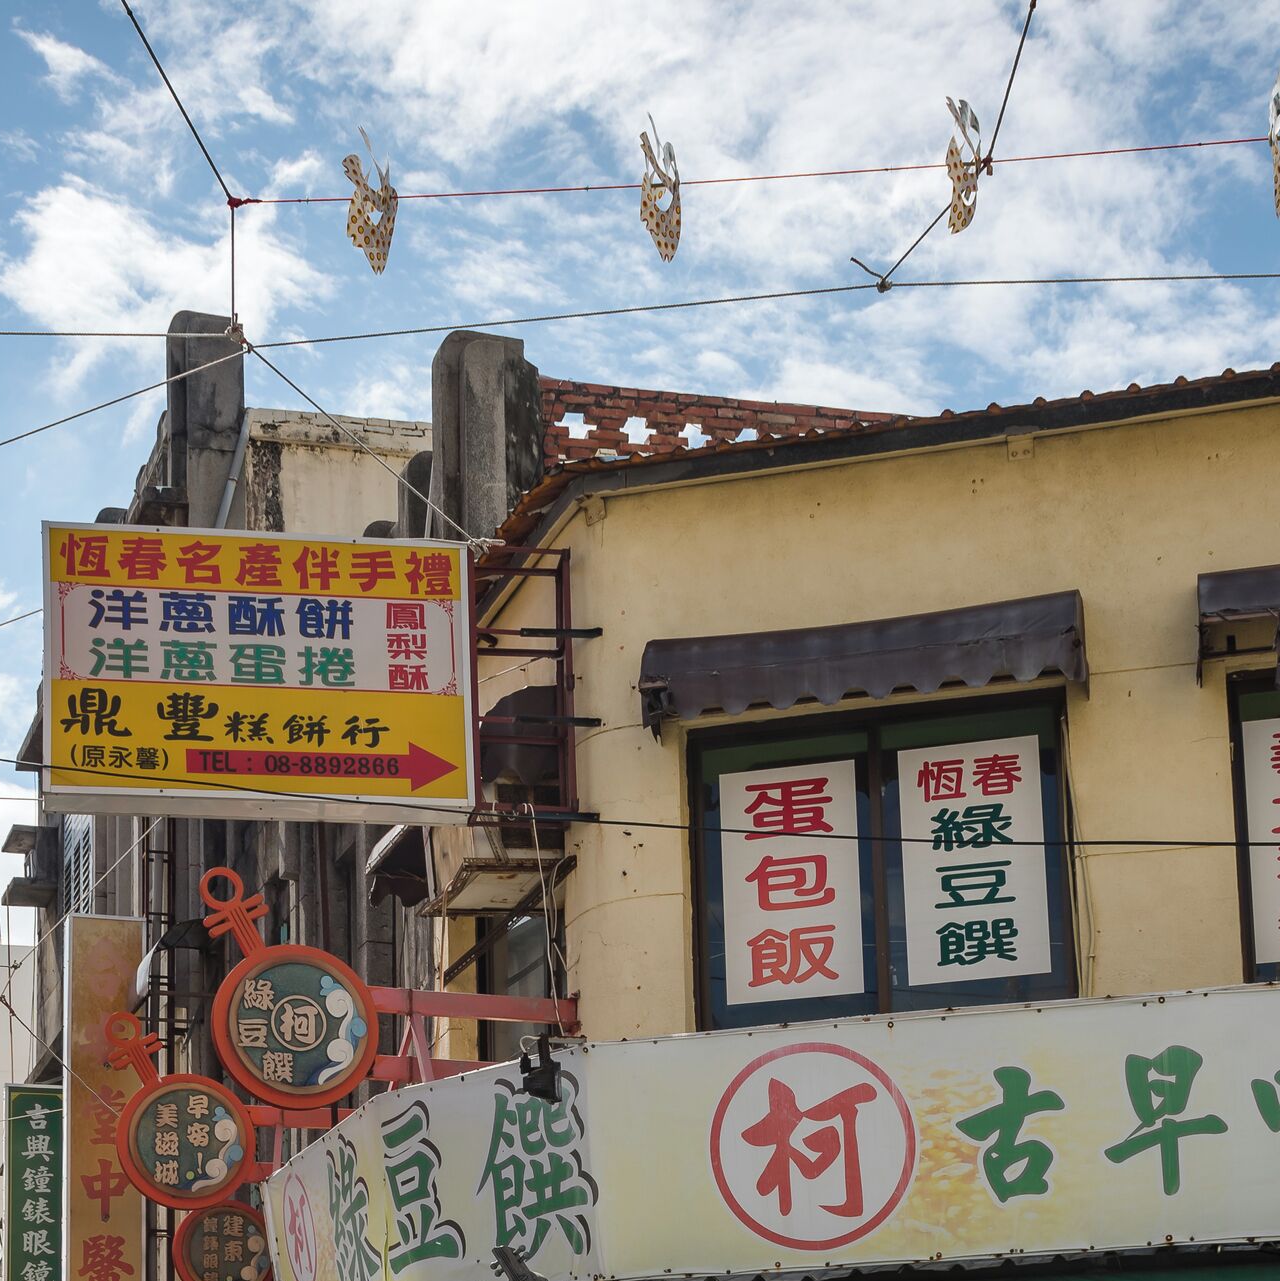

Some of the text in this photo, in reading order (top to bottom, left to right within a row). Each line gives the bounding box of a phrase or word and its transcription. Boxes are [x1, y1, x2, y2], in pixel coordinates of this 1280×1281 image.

[60, 533, 454, 596] 恆春名產伴手禮
[386, 602, 429, 691] 鳳梨酥
[60, 687, 390, 749] 鼎豐糕餅行
[264, 753, 400, 777] 08-8892866
[918, 753, 1022, 803] 恆春
[743, 777, 840, 989] 蛋包飯
[929, 802, 1019, 968] 綠豆饌
[279, 1002, 317, 1045] 柯
[739, 1075, 878, 1219] 柯
